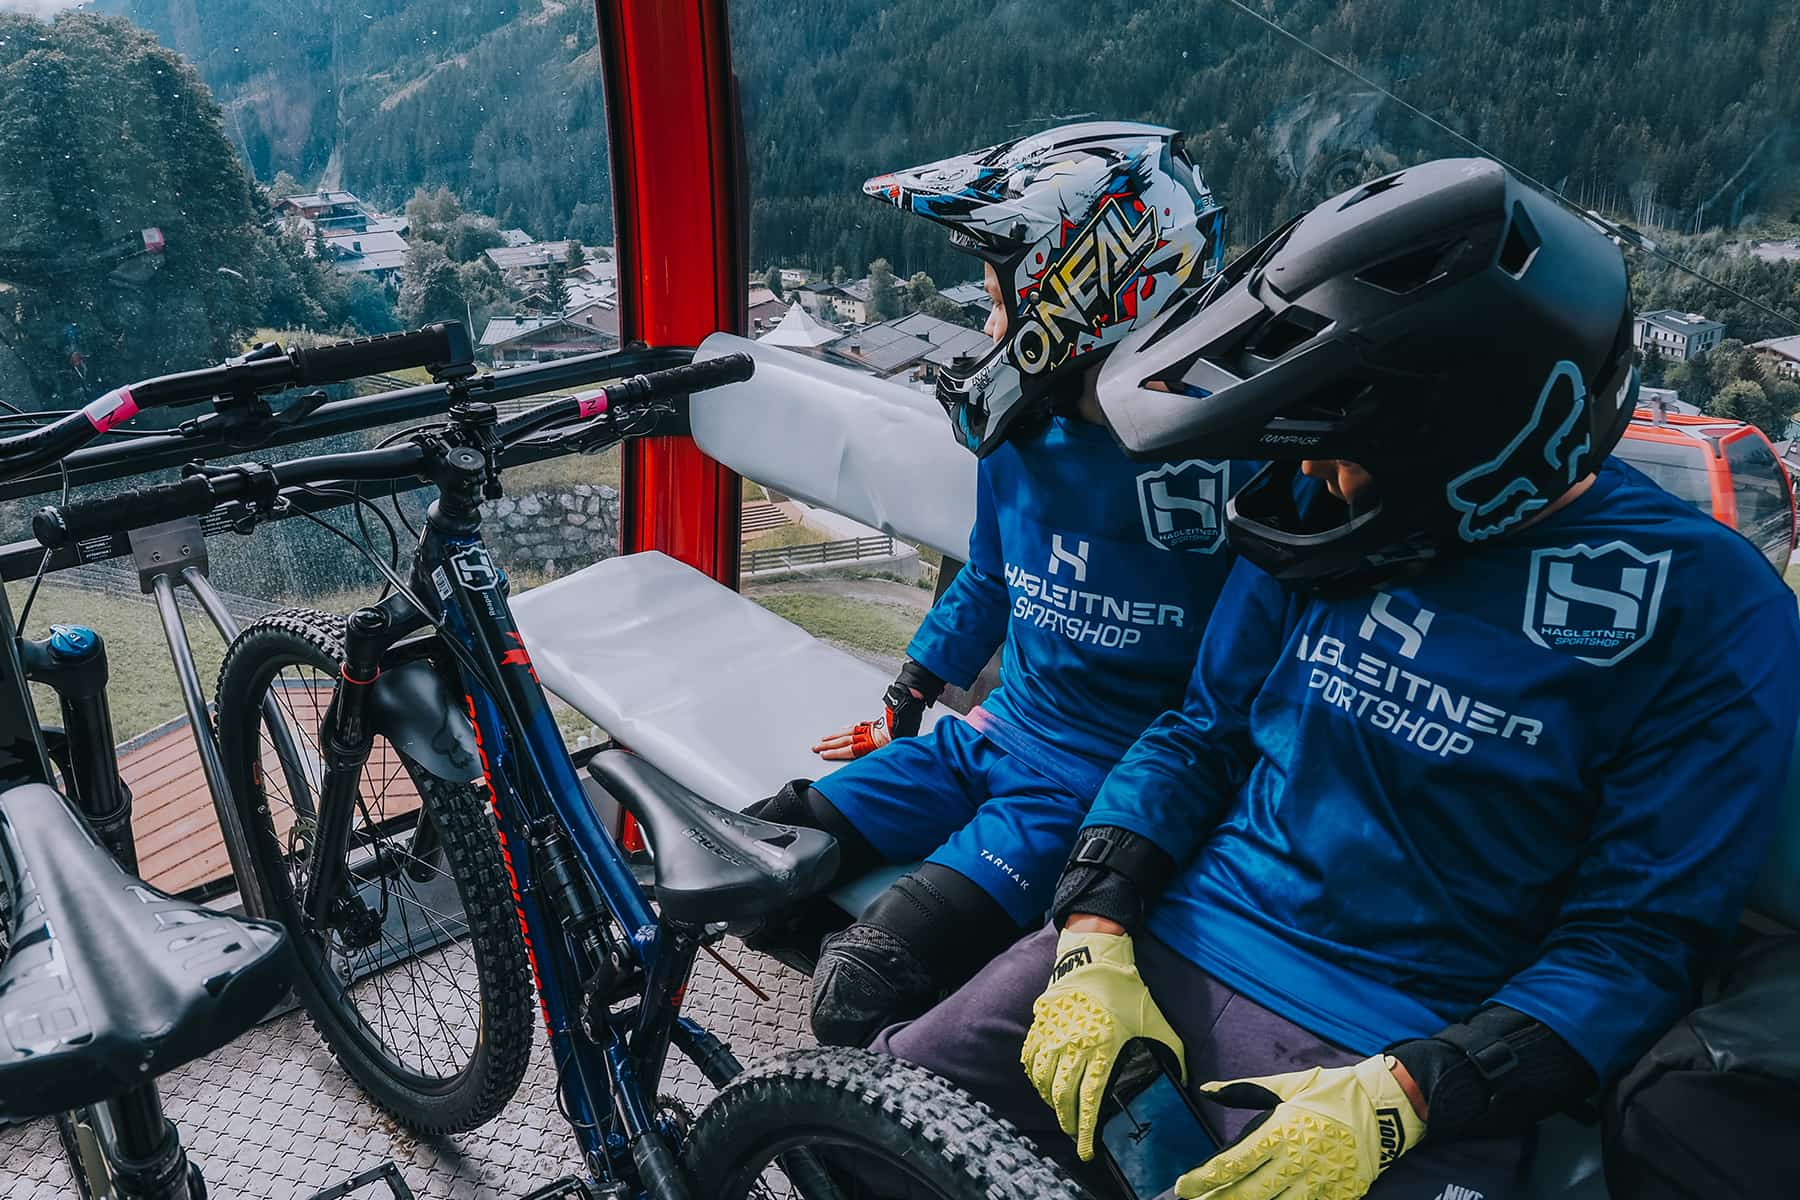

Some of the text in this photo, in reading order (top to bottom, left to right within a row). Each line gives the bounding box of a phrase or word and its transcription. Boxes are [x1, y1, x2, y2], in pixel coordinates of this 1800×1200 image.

[1159, 527, 1218, 540] HAGLEITNER
[1004, 562, 1185, 628] HAGLEITNER
[1541, 626, 1637, 640] HAGLEITNER
[1554, 637, 1620, 648] SPORTSHOP
[1308, 667, 1475, 758] PORTSHOP
[980, 848, 1030, 891] TARMAK
[1057, 952, 1084, 980] 100%
[1378, 1118, 1396, 1161] 100%
